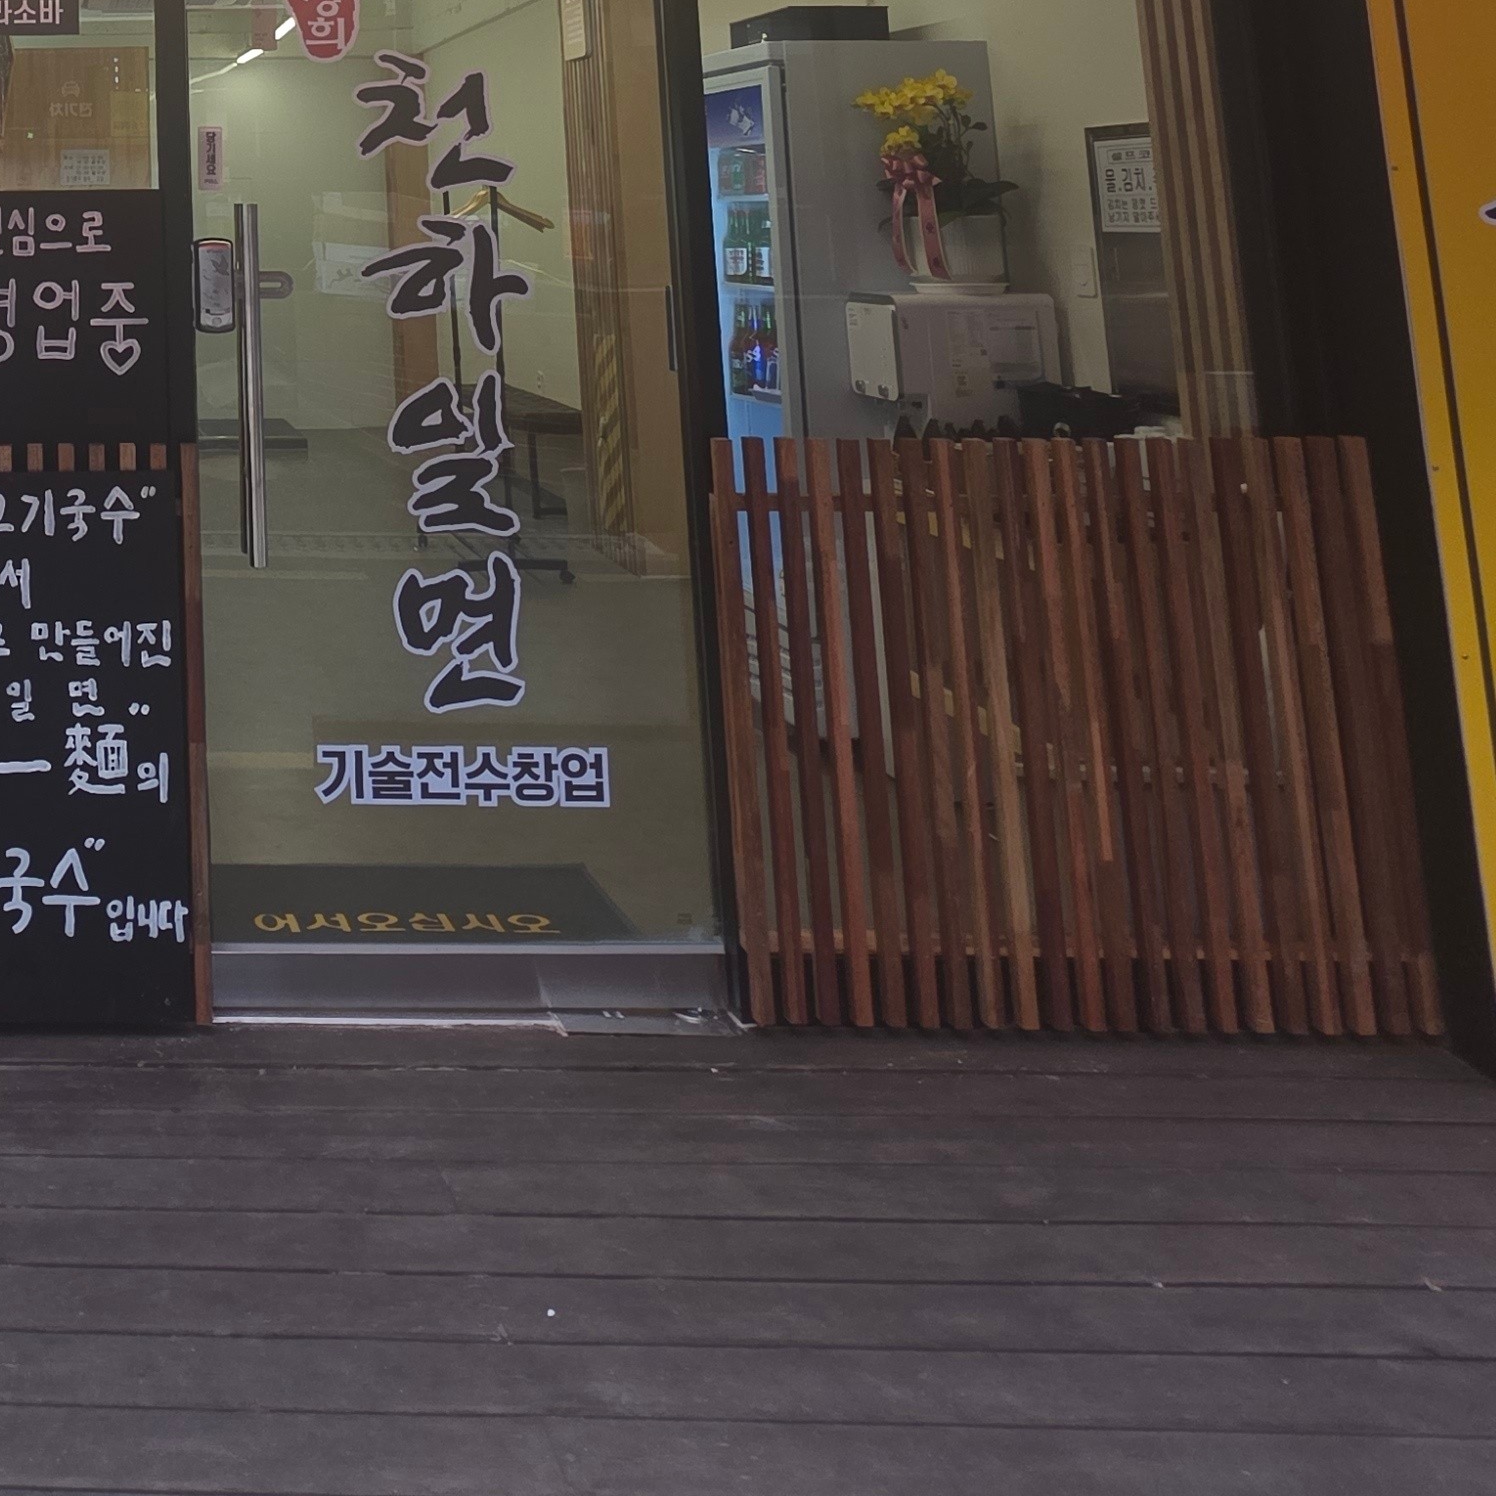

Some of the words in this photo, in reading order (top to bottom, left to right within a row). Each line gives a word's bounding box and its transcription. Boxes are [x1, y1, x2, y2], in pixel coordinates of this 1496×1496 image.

[30, 620, 172, 667] 만들어진
[315, 745, 611, 807] 기술전수창업
[254, 912, 561, 934] 어서오십시오
